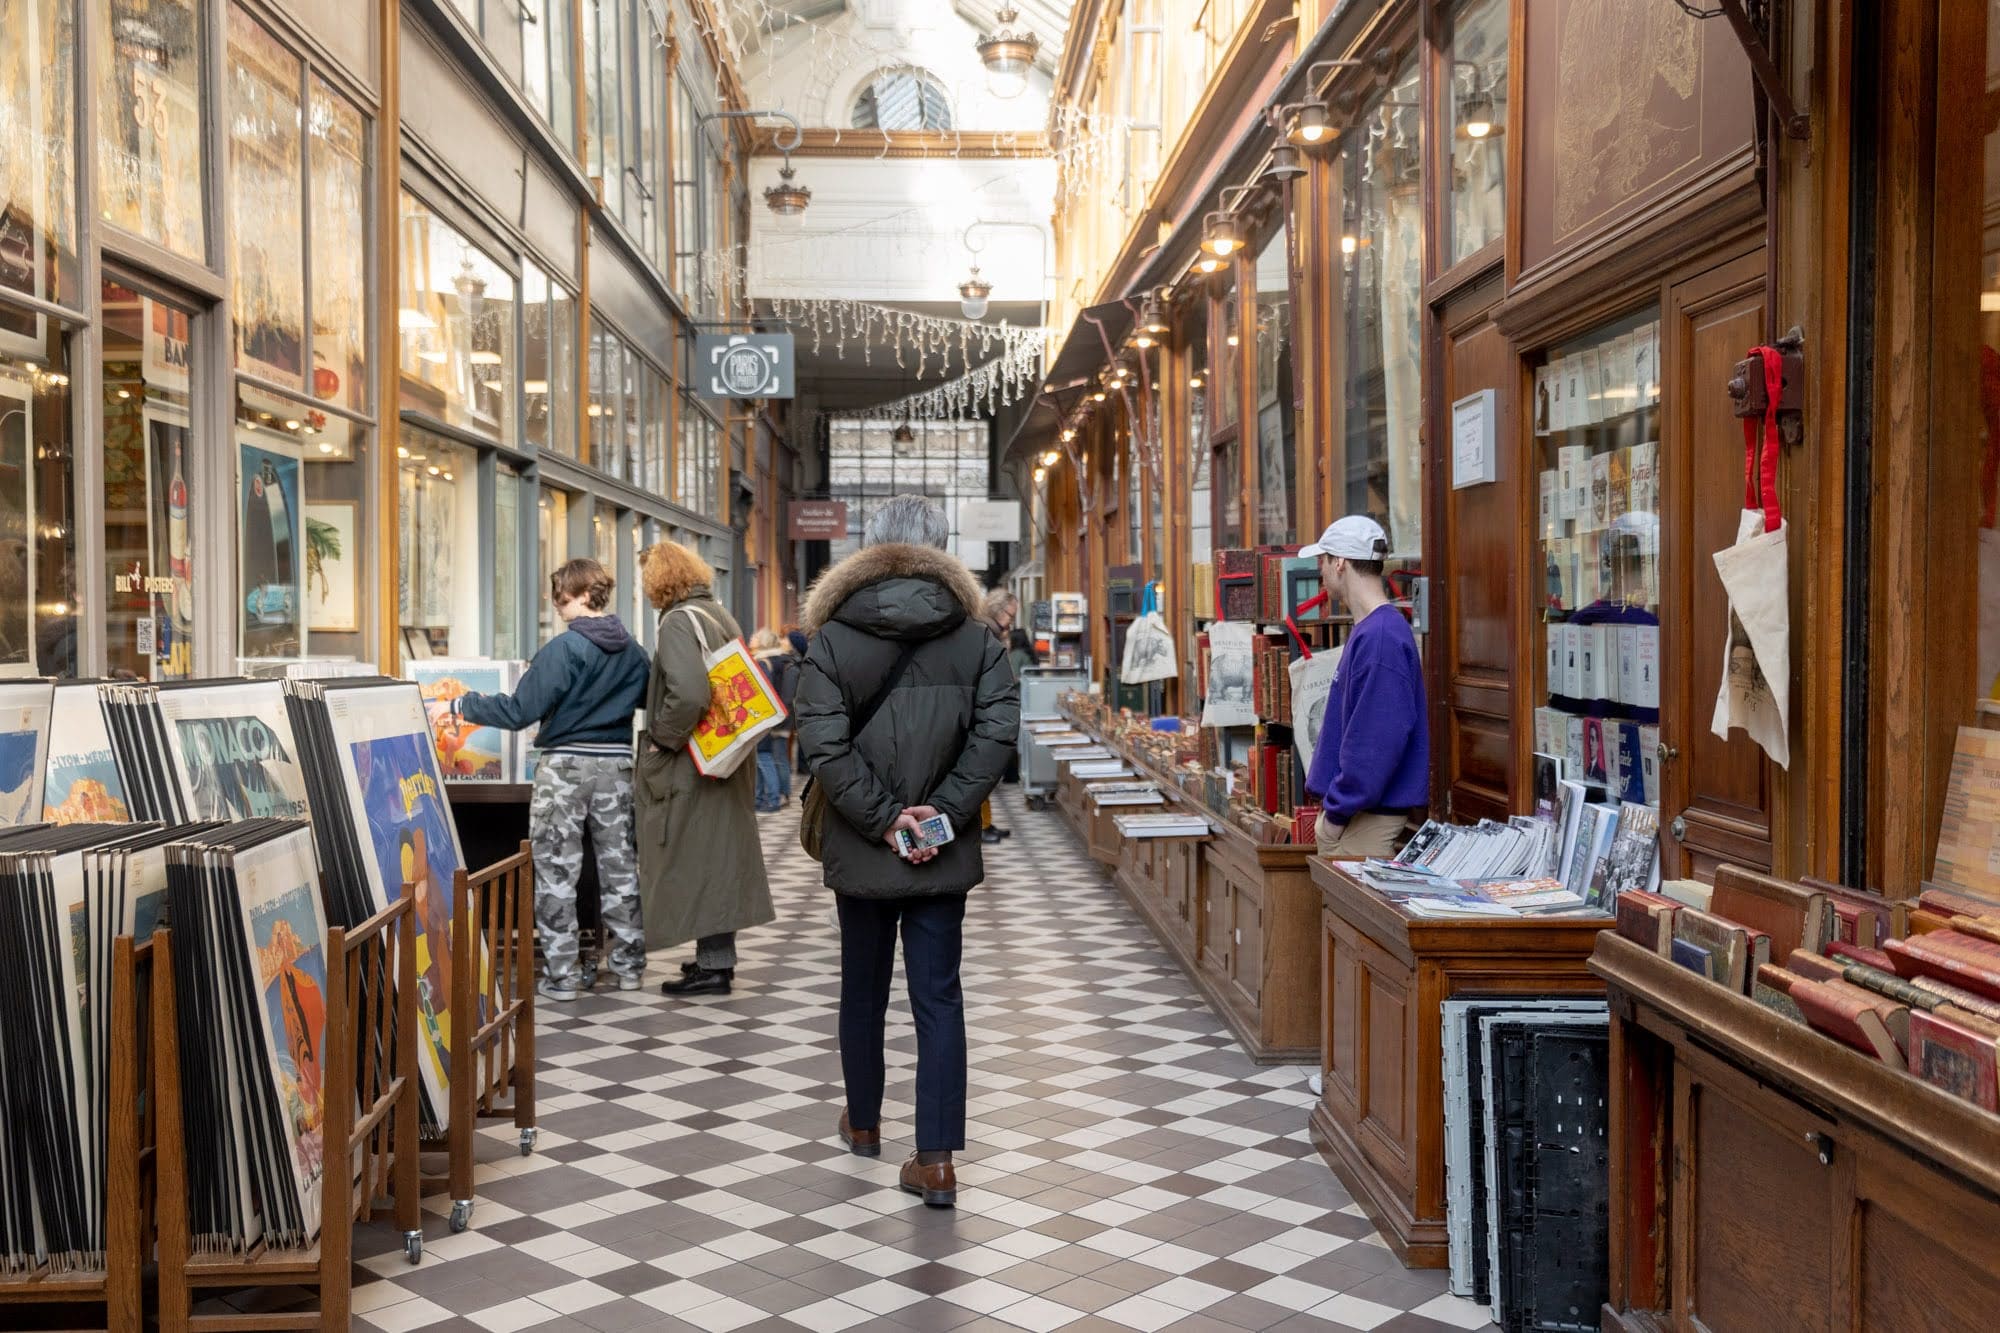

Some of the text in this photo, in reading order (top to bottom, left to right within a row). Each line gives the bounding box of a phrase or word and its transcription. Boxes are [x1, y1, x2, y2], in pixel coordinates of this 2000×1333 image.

[729, 353, 759, 376] PARIS
[115, 574, 174, 593] BILL POSTERS
[176, 719, 270, 768] MONACO
